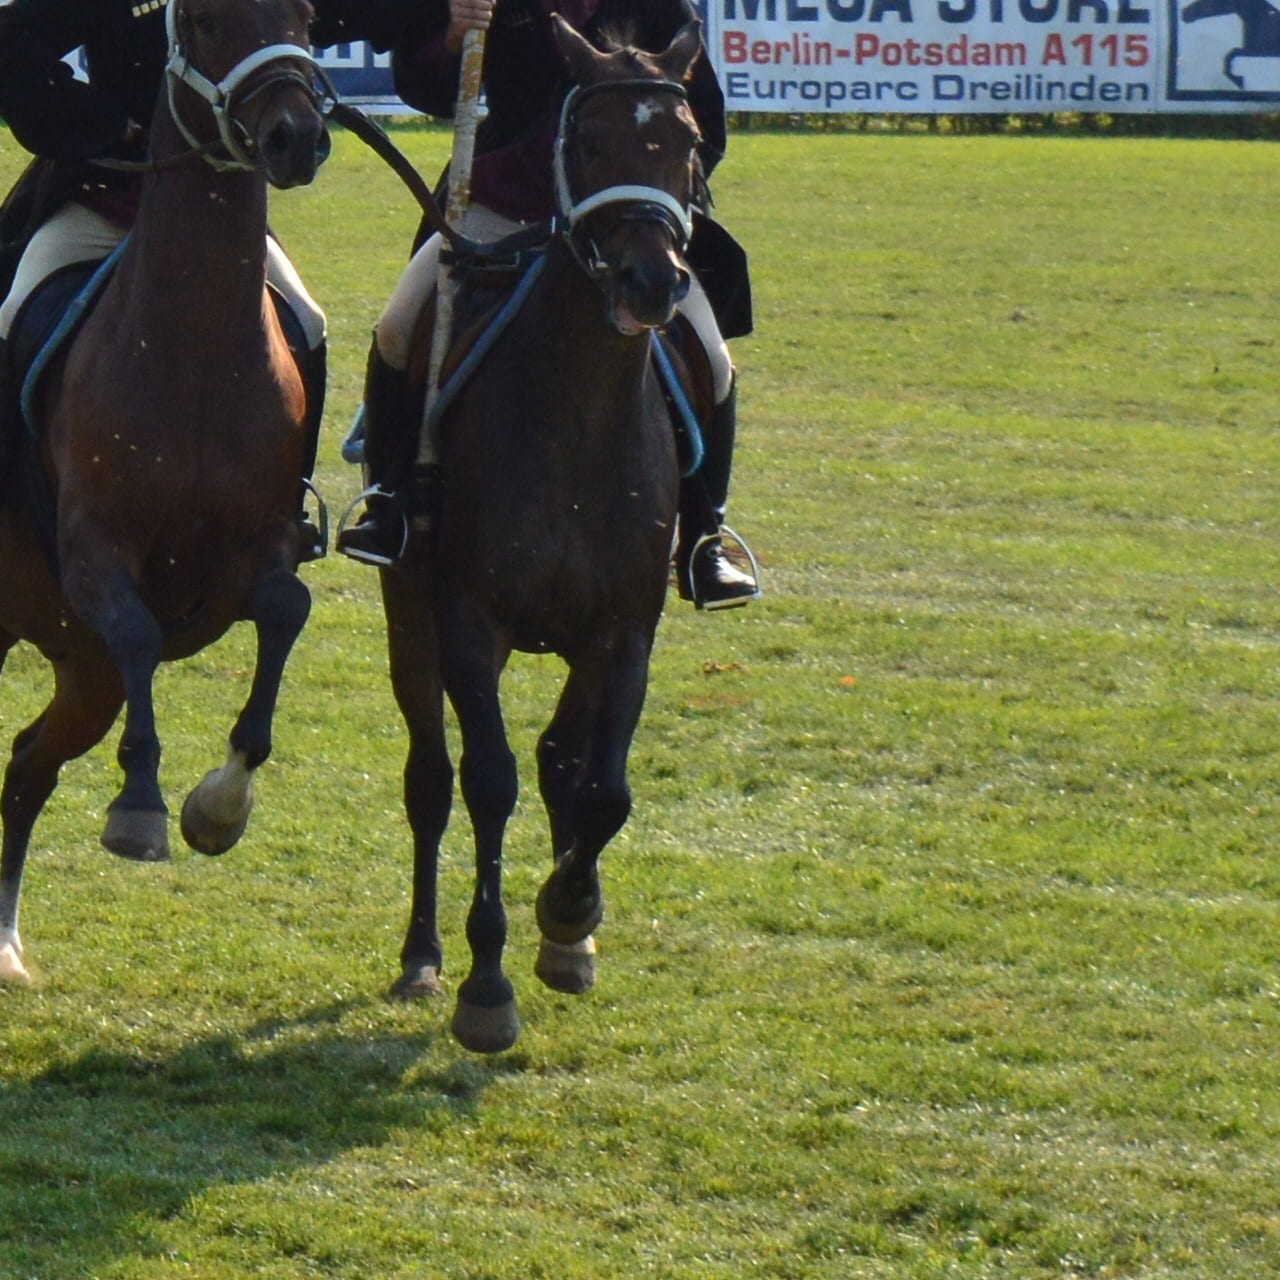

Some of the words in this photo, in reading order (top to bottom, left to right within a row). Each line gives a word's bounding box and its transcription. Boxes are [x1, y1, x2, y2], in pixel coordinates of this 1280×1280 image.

[724, 31, 1026, 66] Berlin-Potsdam
[1041, 33, 1150, 67] A115
[726, 72, 918, 108] Europarc
[933, 74, 1149, 101] Dreilinden
